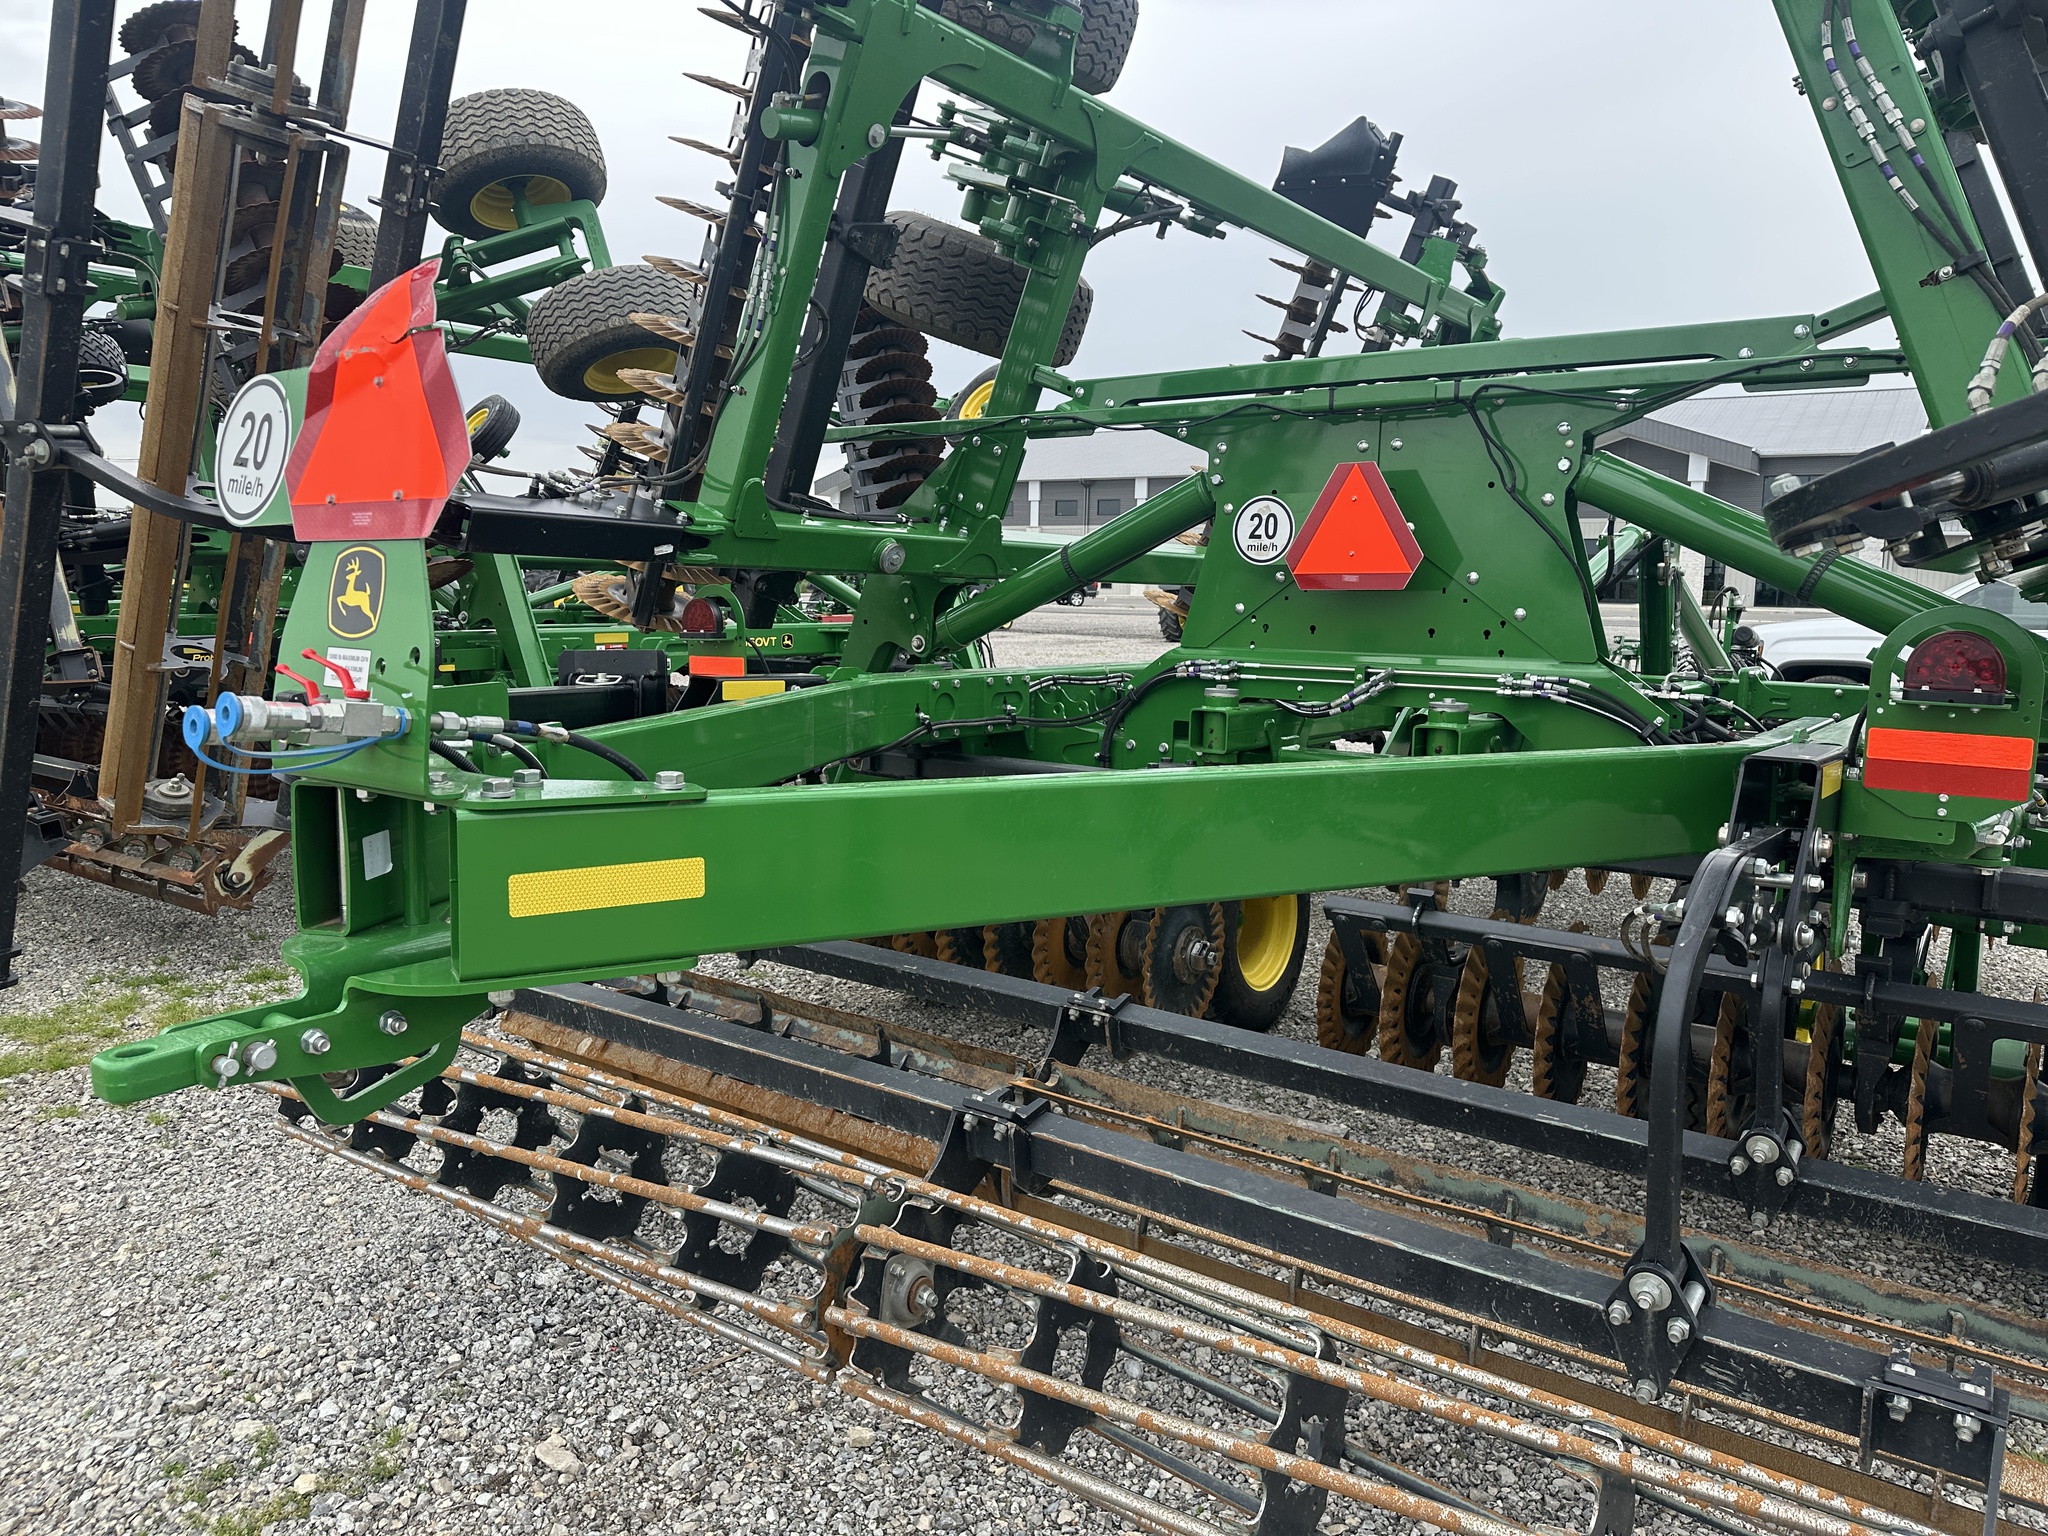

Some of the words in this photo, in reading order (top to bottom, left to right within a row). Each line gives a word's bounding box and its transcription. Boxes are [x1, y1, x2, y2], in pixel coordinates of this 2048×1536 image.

[233, 411, 272, 471] 20
[227, 475, 264, 498] mile/h
[1248, 513, 1278, 540] 20
[1246, 542, 1278, 552] mile/h
